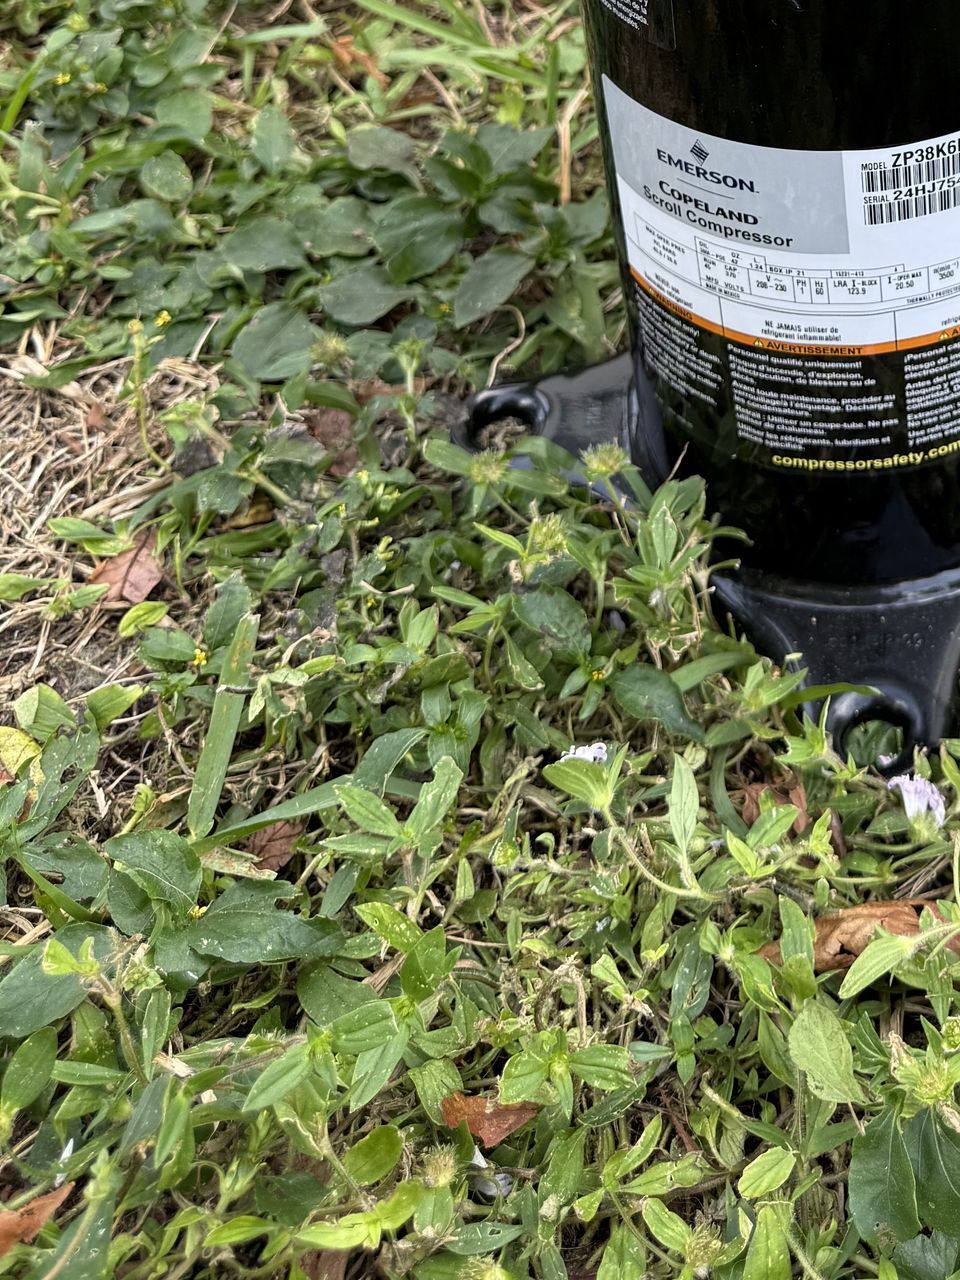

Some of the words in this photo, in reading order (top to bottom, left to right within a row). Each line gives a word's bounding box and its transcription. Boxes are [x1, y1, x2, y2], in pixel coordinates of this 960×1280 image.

[656, 148, 756, 193] EMERSON
[861, 161, 888, 172] MODEL
[658, 180, 760, 225] COPELAND
[863, 194, 890, 205] SERIAL
[643, 184, 682, 218] Scroll
[686, 210, 794, 248] Compressor
[724, 264, 738, 273] CAP
[769, 266, 783, 274] BOX
[938, 269, 954, 281] 3500
[765, 274, 772, 283] V
[796, 279, 808, 288] PH
[814, 280, 824, 288] Hz
[833, 279, 848, 288] LRA
[801, 287, 805, 295] 1
[815, 288, 825, 296] 60
[847, 287, 867, 296] 123.9
[894, 280, 915, 291] 20.50
[906, 293, 935, 305] THERMALLY
[776, 321, 803, 333] JAMAIS
[804, 325, 828, 334] utiliser
[830, 326, 840, 334] de
[766, 340, 864, 356] AVERTISSEMENT
[727, 343, 769, 362] Personnel
[770, 355, 803, 369] qualifié
[804, 359, 863, 371] uniquement!
[904, 360, 937, 374] Riesgo
[937, 355, 950, 366] de
[758, 363, 806, 379] d'incendie,
[807, 370, 865, 381] d'explosion,
[796, 375, 808, 385] de
[809, 378, 849, 388] blessure
[849, 379, 863, 388] ou
[864, 377, 877, 387] de
[905, 379, 933, 392] Antes
[932, 374, 948, 386] del
[756, 386, 779, 399] toute
[779, 393, 841, 406] maintenance,
[841, 393, 883, 406] procéder
[883, 393, 896, 402] au
[905, 384, 943, 399] bloqueo
[746, 398, 813, 418] condensateurs.
[845, 400, 895, 413] Déchargez
[906, 402, 957, 421] Extracción:
[767, 413, 798, 427] Utiliser
[799, 419, 812, 428] un
[812, 420, 867, 431] coupe-tube.
[867, 419, 880, 429] Ne
[881, 418, 900, 429] pas
[906, 418, 921, 429] No
[921, 415, 938, 427] use
[938, 410, 952, 422] un
[763, 420, 775, 430] de
[776, 423, 828, 436] chalumeau.
[907, 428, 926, 441] Use
[765, 431, 779, 441] les
[779, 434, 834, 448] réfrigérants,
[834, 437, 880, 448] lubrifiants
[880, 435, 892, 445] et
